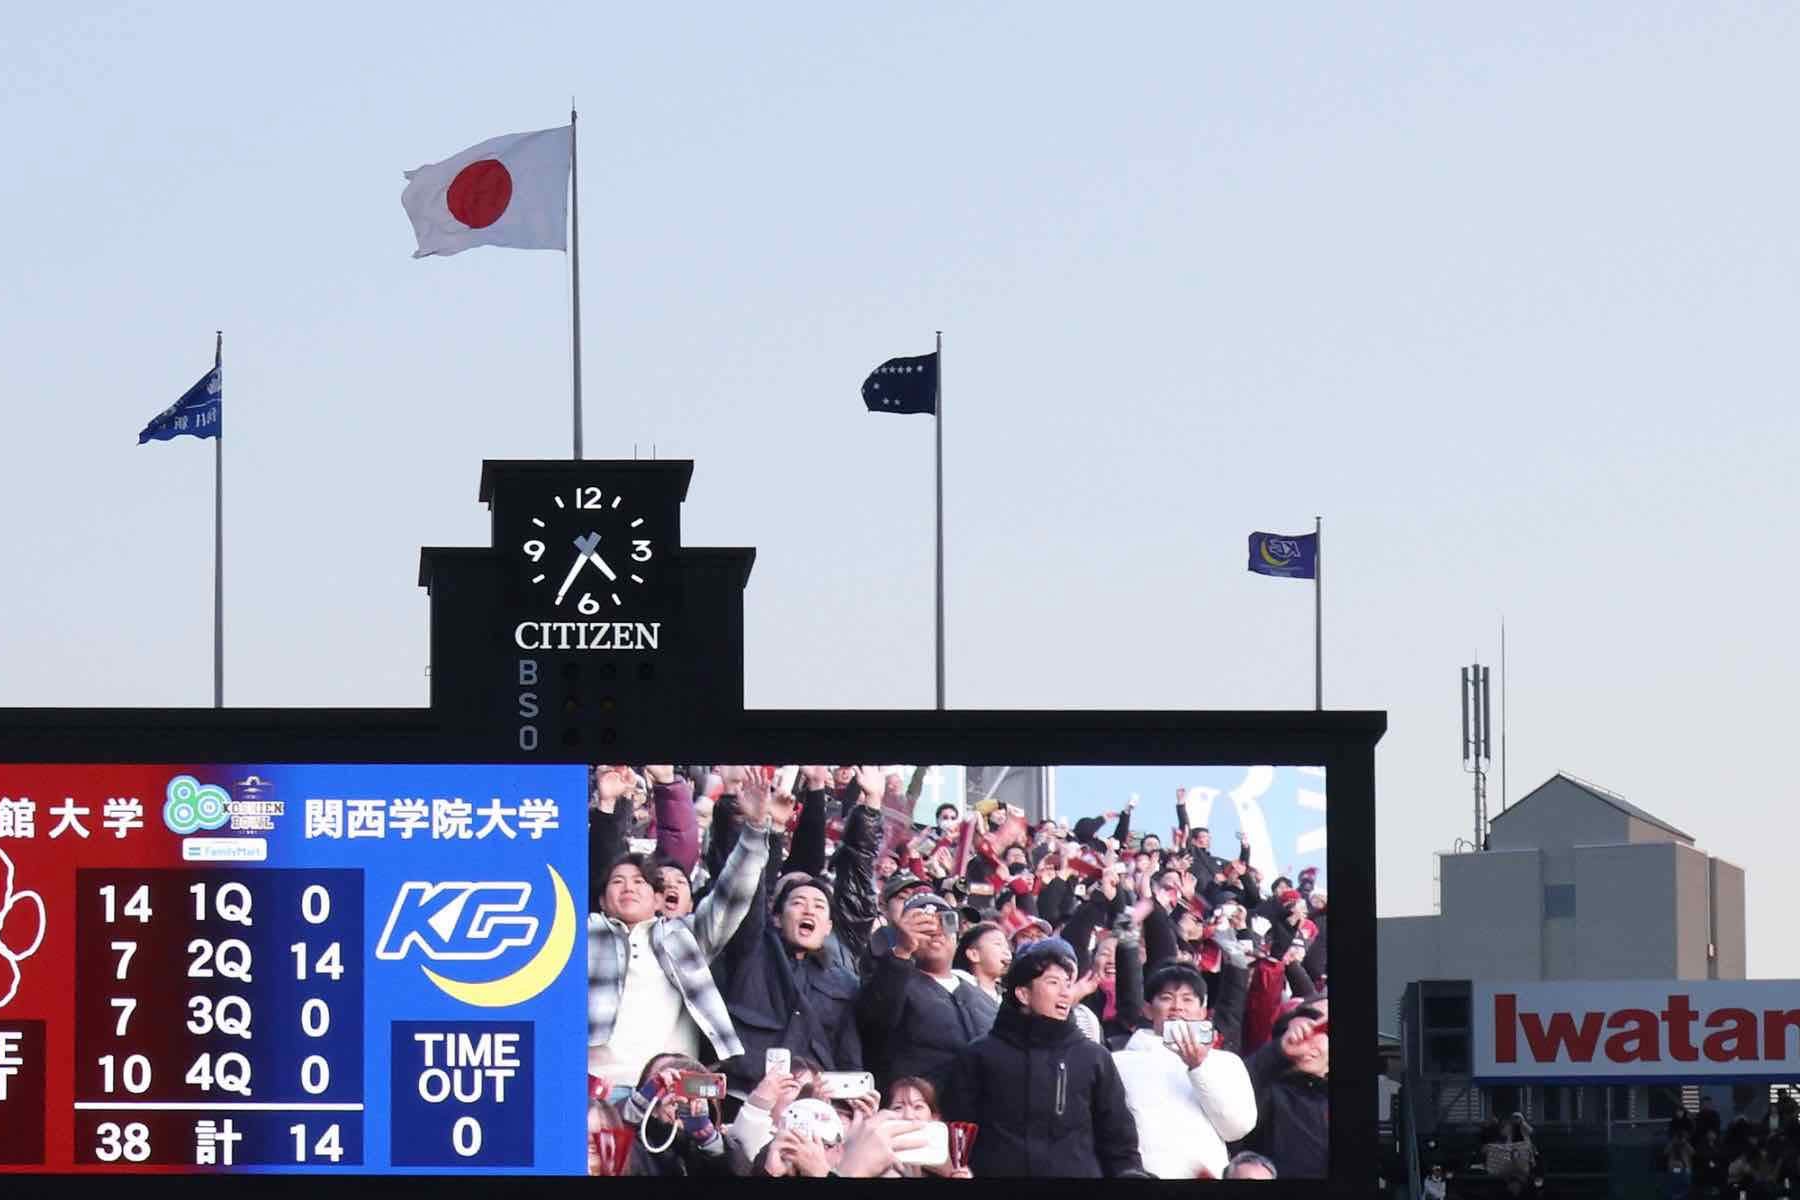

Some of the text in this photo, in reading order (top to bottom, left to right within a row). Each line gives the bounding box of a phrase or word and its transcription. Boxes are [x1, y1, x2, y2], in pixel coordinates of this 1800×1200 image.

[575, 487, 602, 509] 12
[523, 540, 545, 562] 9
[631, 540, 652, 562] 3
[577, 593, 600, 615] 6
[514, 622, 661, 650] CITIZEN
[519, 659, 538, 685] B
[519, 692, 538, 718] S
[519, 725, 538, 752] O
[305, 798, 560, 840] 関西学院大学
[99, 882, 330, 925] 14 1Q 0
[112, 939, 344, 982] 7 2Q 14
[112, 997, 330, 1039] 7 3Q 0
[414, 1034, 520, 1067] TIME
[98, 1053, 330, 1097] 10 4Q 0
[418, 1069, 514, 1103] OUT
[95, 1120, 344, 1166] 38 計 14
[453, 1118, 481, 1156] 0
